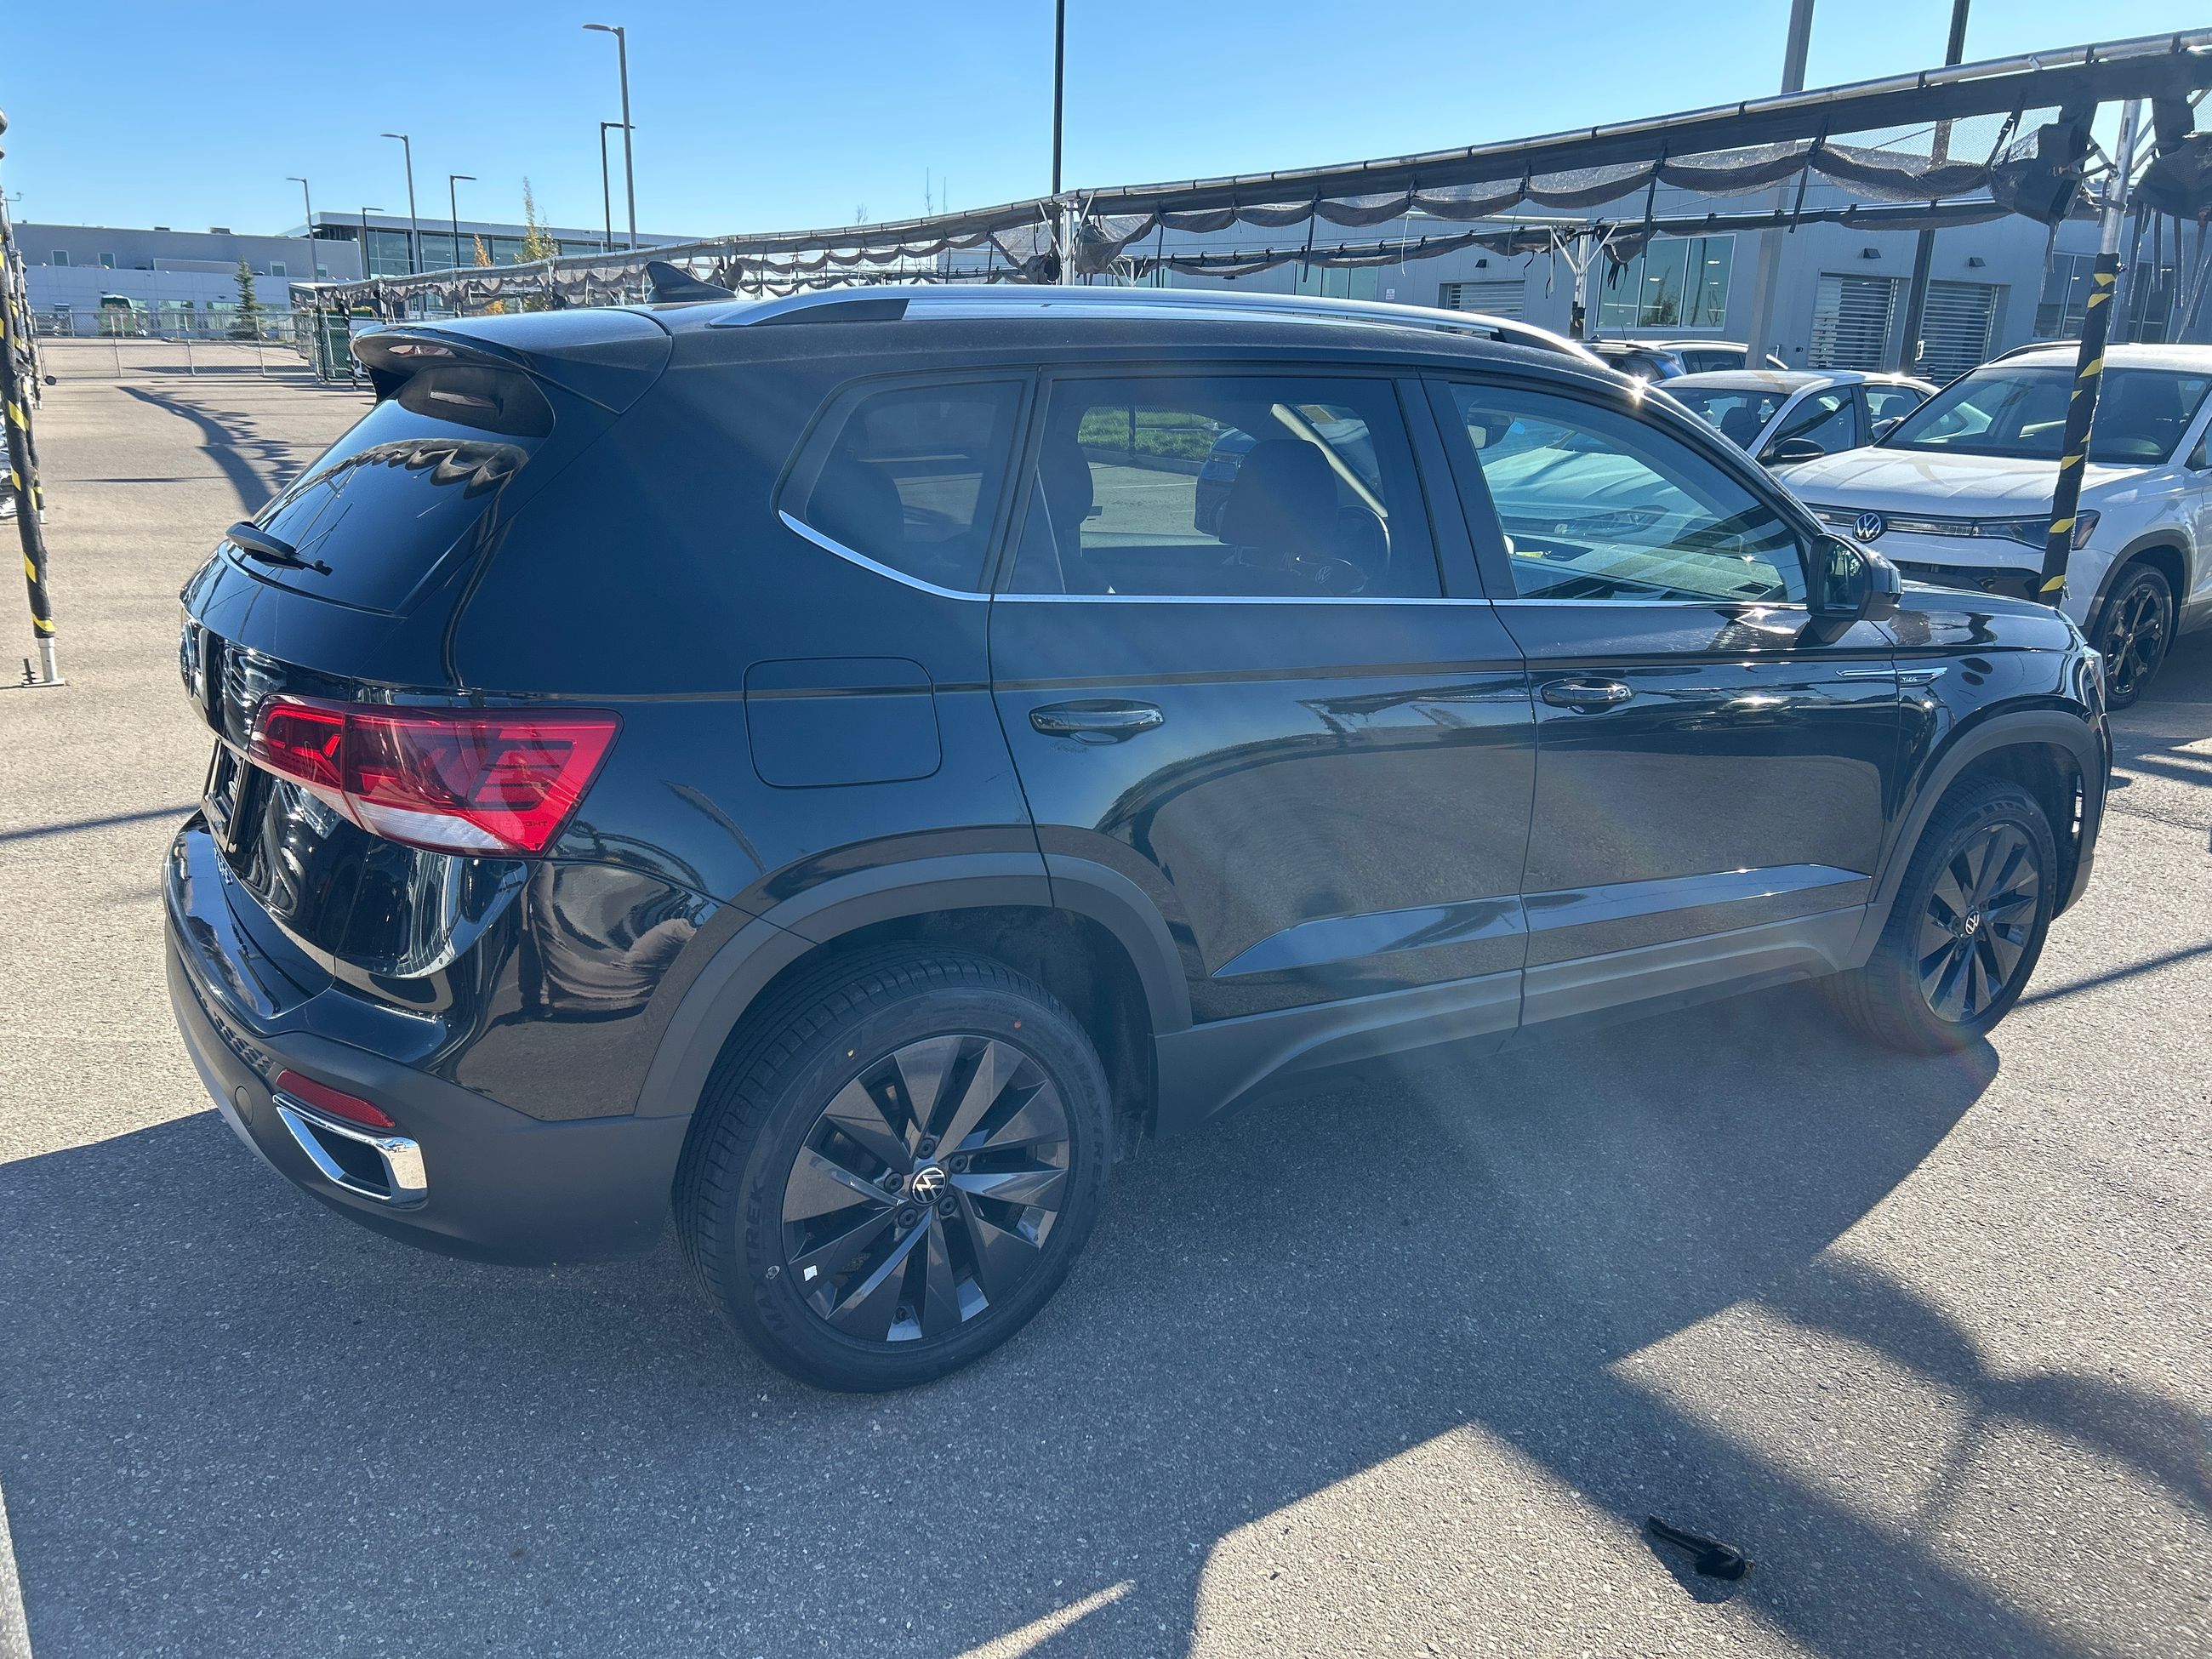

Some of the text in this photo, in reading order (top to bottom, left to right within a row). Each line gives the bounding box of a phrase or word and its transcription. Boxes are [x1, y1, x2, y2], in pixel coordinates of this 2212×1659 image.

[1854, 512, 1881, 542] VW
[913, 1166, 945, 1204] VW
[745, 1175, 790, 1332] MAXTREK
